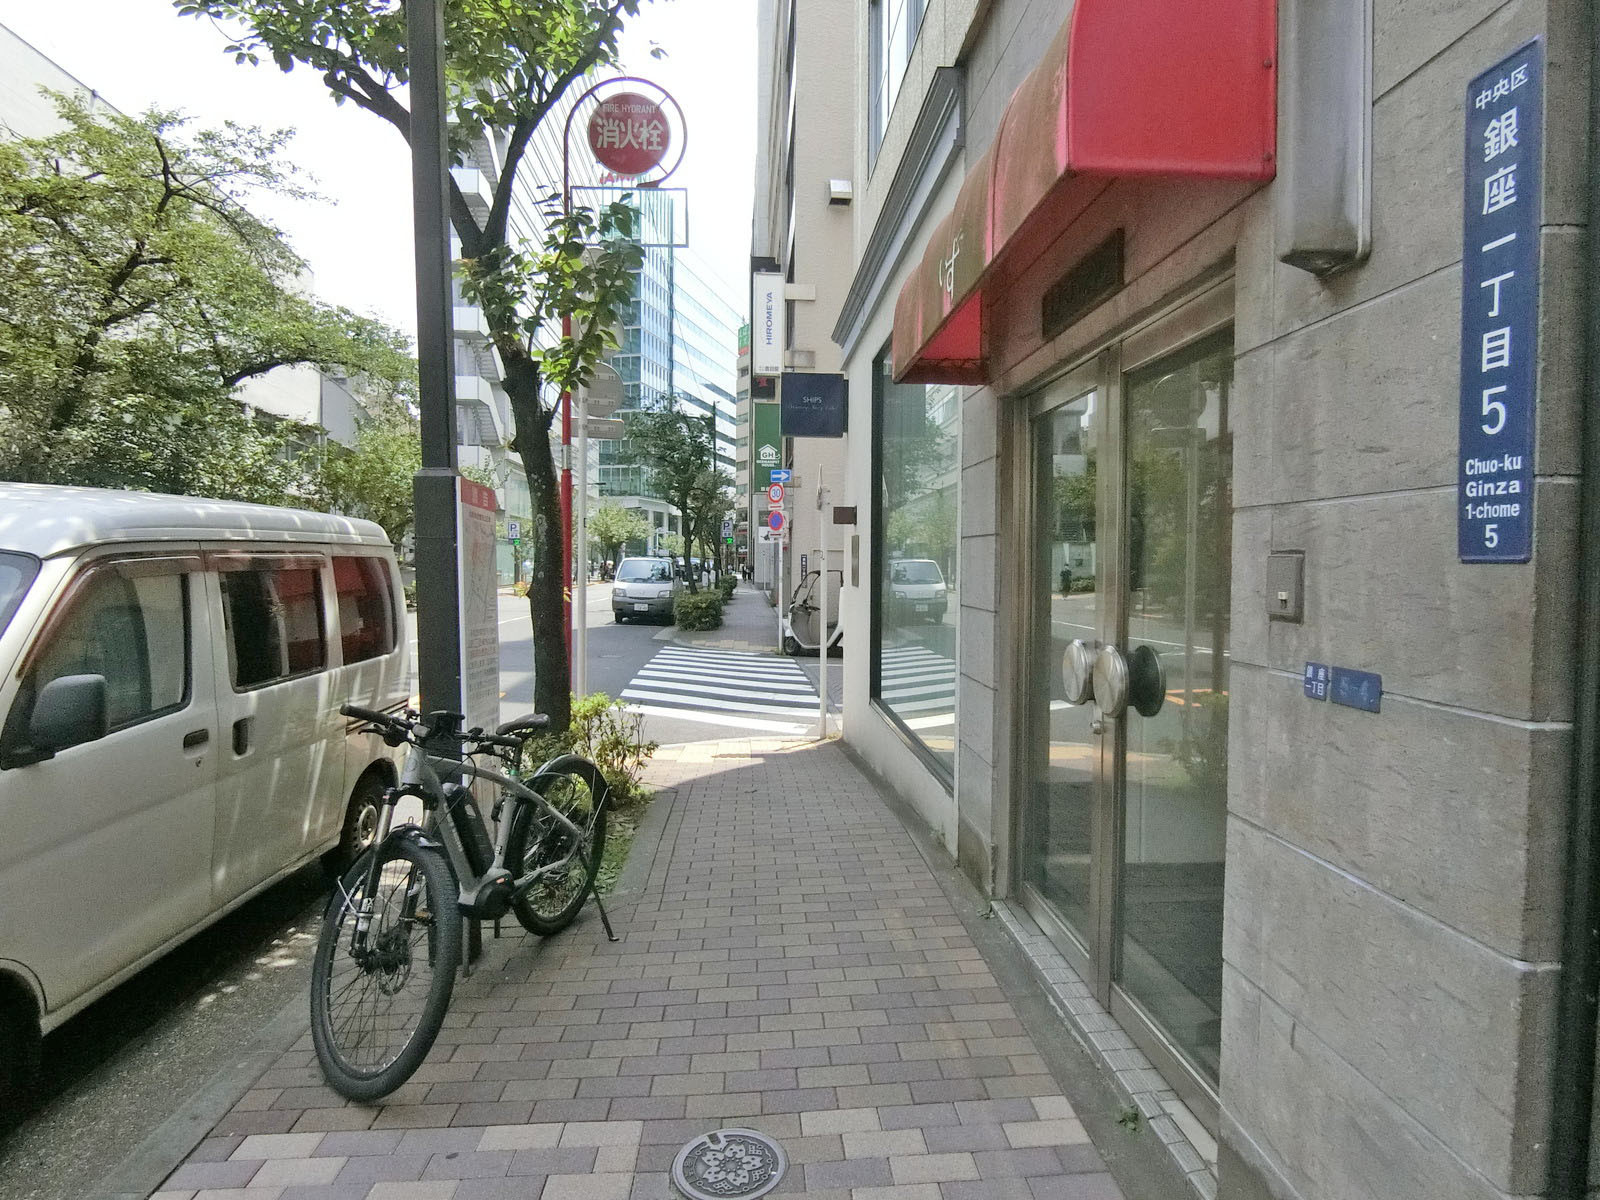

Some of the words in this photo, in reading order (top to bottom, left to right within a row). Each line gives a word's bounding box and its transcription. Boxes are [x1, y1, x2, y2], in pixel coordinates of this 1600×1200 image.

[1475, 62, 1529, 110] 中央区
[602, 103, 620, 113] FIRE
[621, 104, 657, 114] HYDRANT
[595, 117, 665, 151] 消火栓
[765, 291, 773, 345] HIROMEYA
[802, 396, 823, 404] SHIPS
[1465, 453, 1522, 475] Chuo-ku
[771, 489, 780, 498] 30
[1465, 479, 1521, 497] Ginza
[1465, 501, 1520, 520] 1-chome
[510, 523, 517, 532] P
[723, 521, 730, 531] P
[1484, 523, 1498, 548] 5
